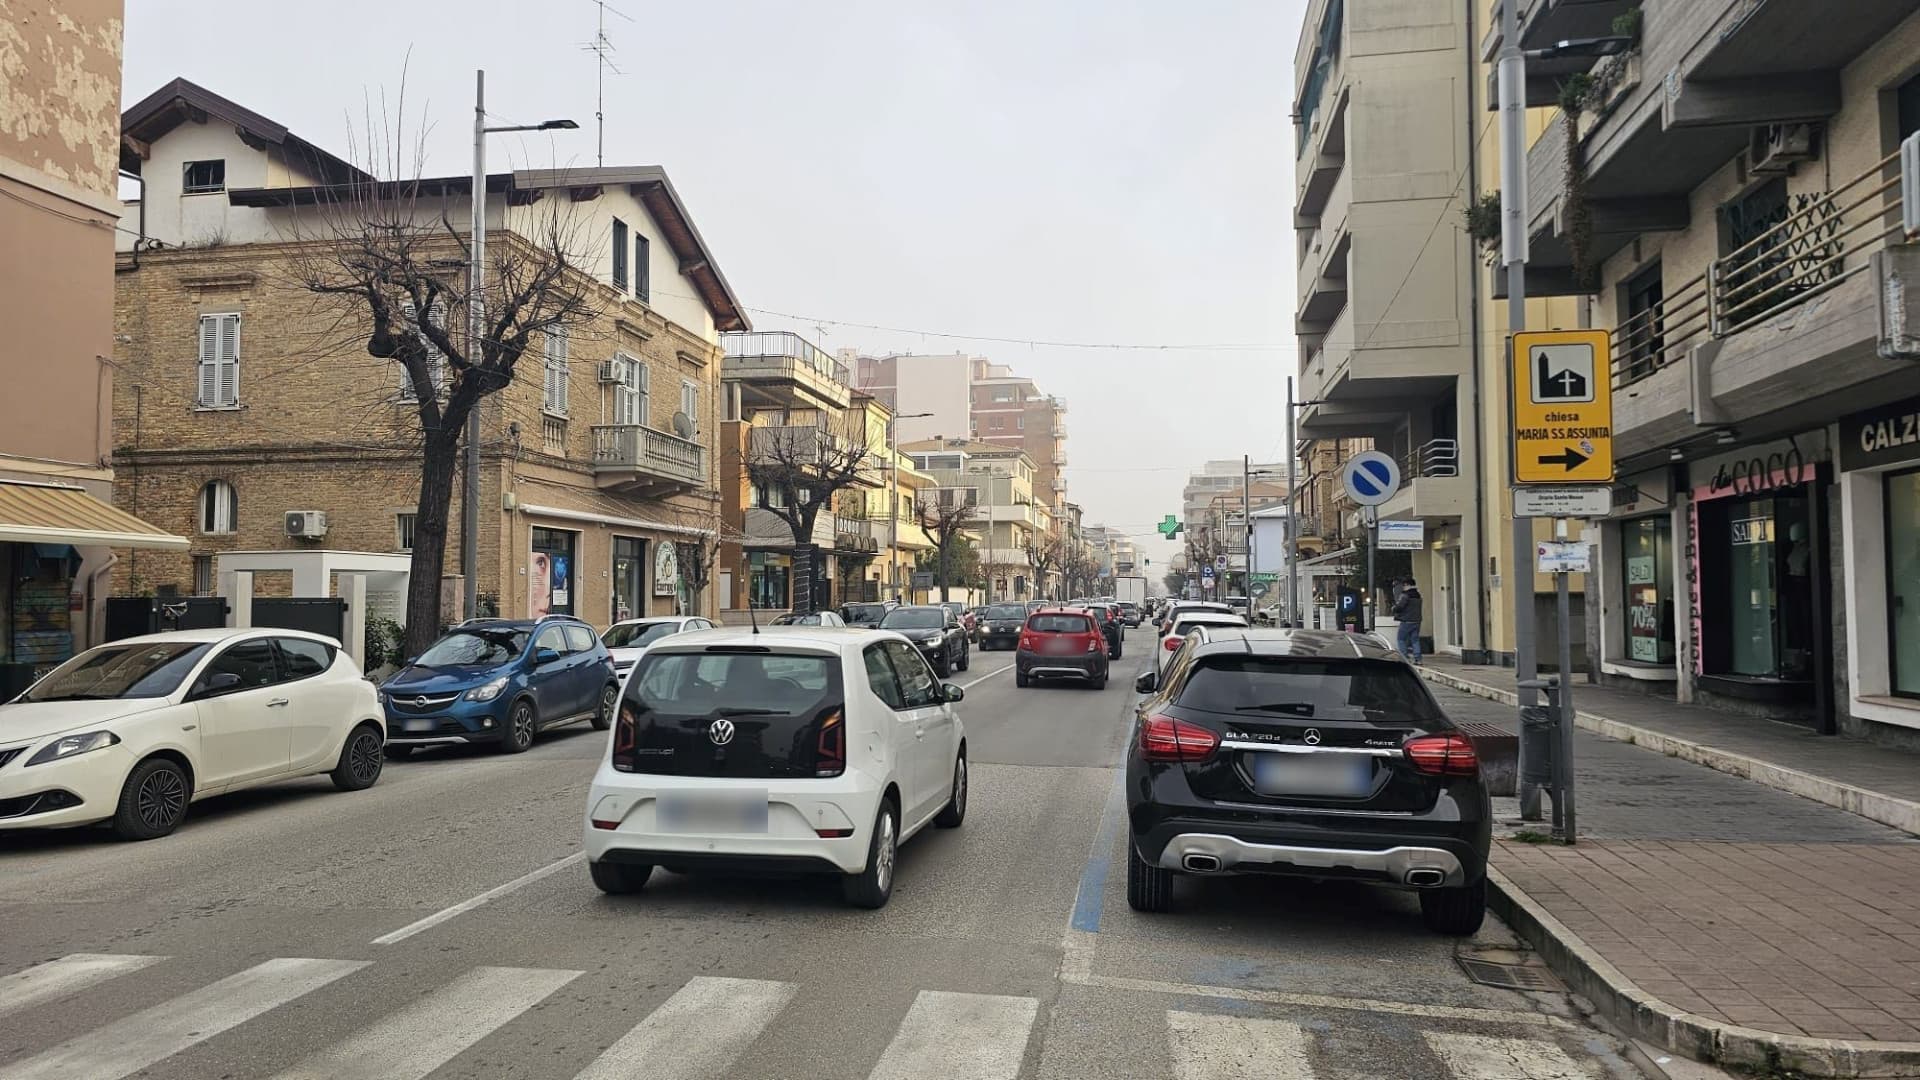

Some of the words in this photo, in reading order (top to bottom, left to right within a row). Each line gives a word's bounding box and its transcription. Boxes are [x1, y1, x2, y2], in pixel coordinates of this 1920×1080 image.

[1545, 411, 1579, 422] chiesa
[1517, 428, 1549, 440] MARIA
[1567, 427, 1610, 438] ASSUNTA
[1733, 520, 1765, 542] SALI
[1686, 566, 1698, 584] &
[1343, 595, 1353, 609] P
[1631, 605, 1657, 630] 70%
